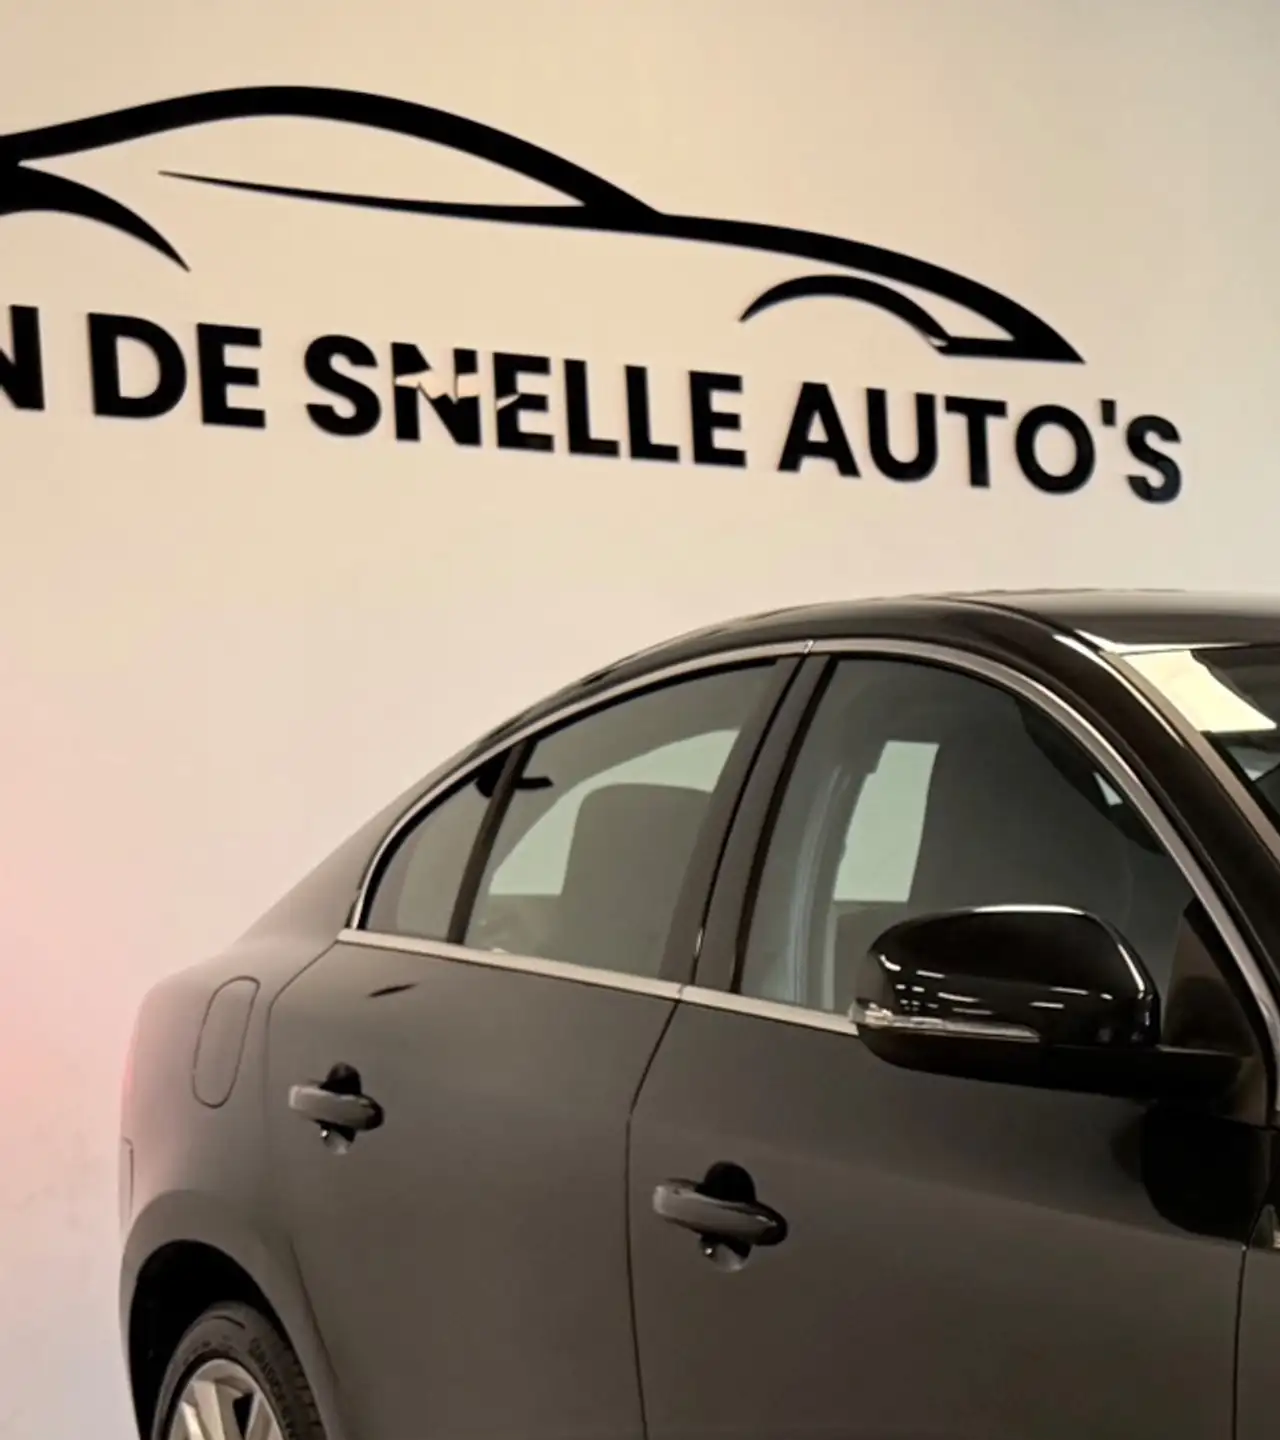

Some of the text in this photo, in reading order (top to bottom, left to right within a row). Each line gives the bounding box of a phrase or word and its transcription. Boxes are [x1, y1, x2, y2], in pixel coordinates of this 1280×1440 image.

[85, 310, 267, 430] DE
[302, 333, 748, 469] SNELLE
[775, 380, 1182, 504] AUTO'S
